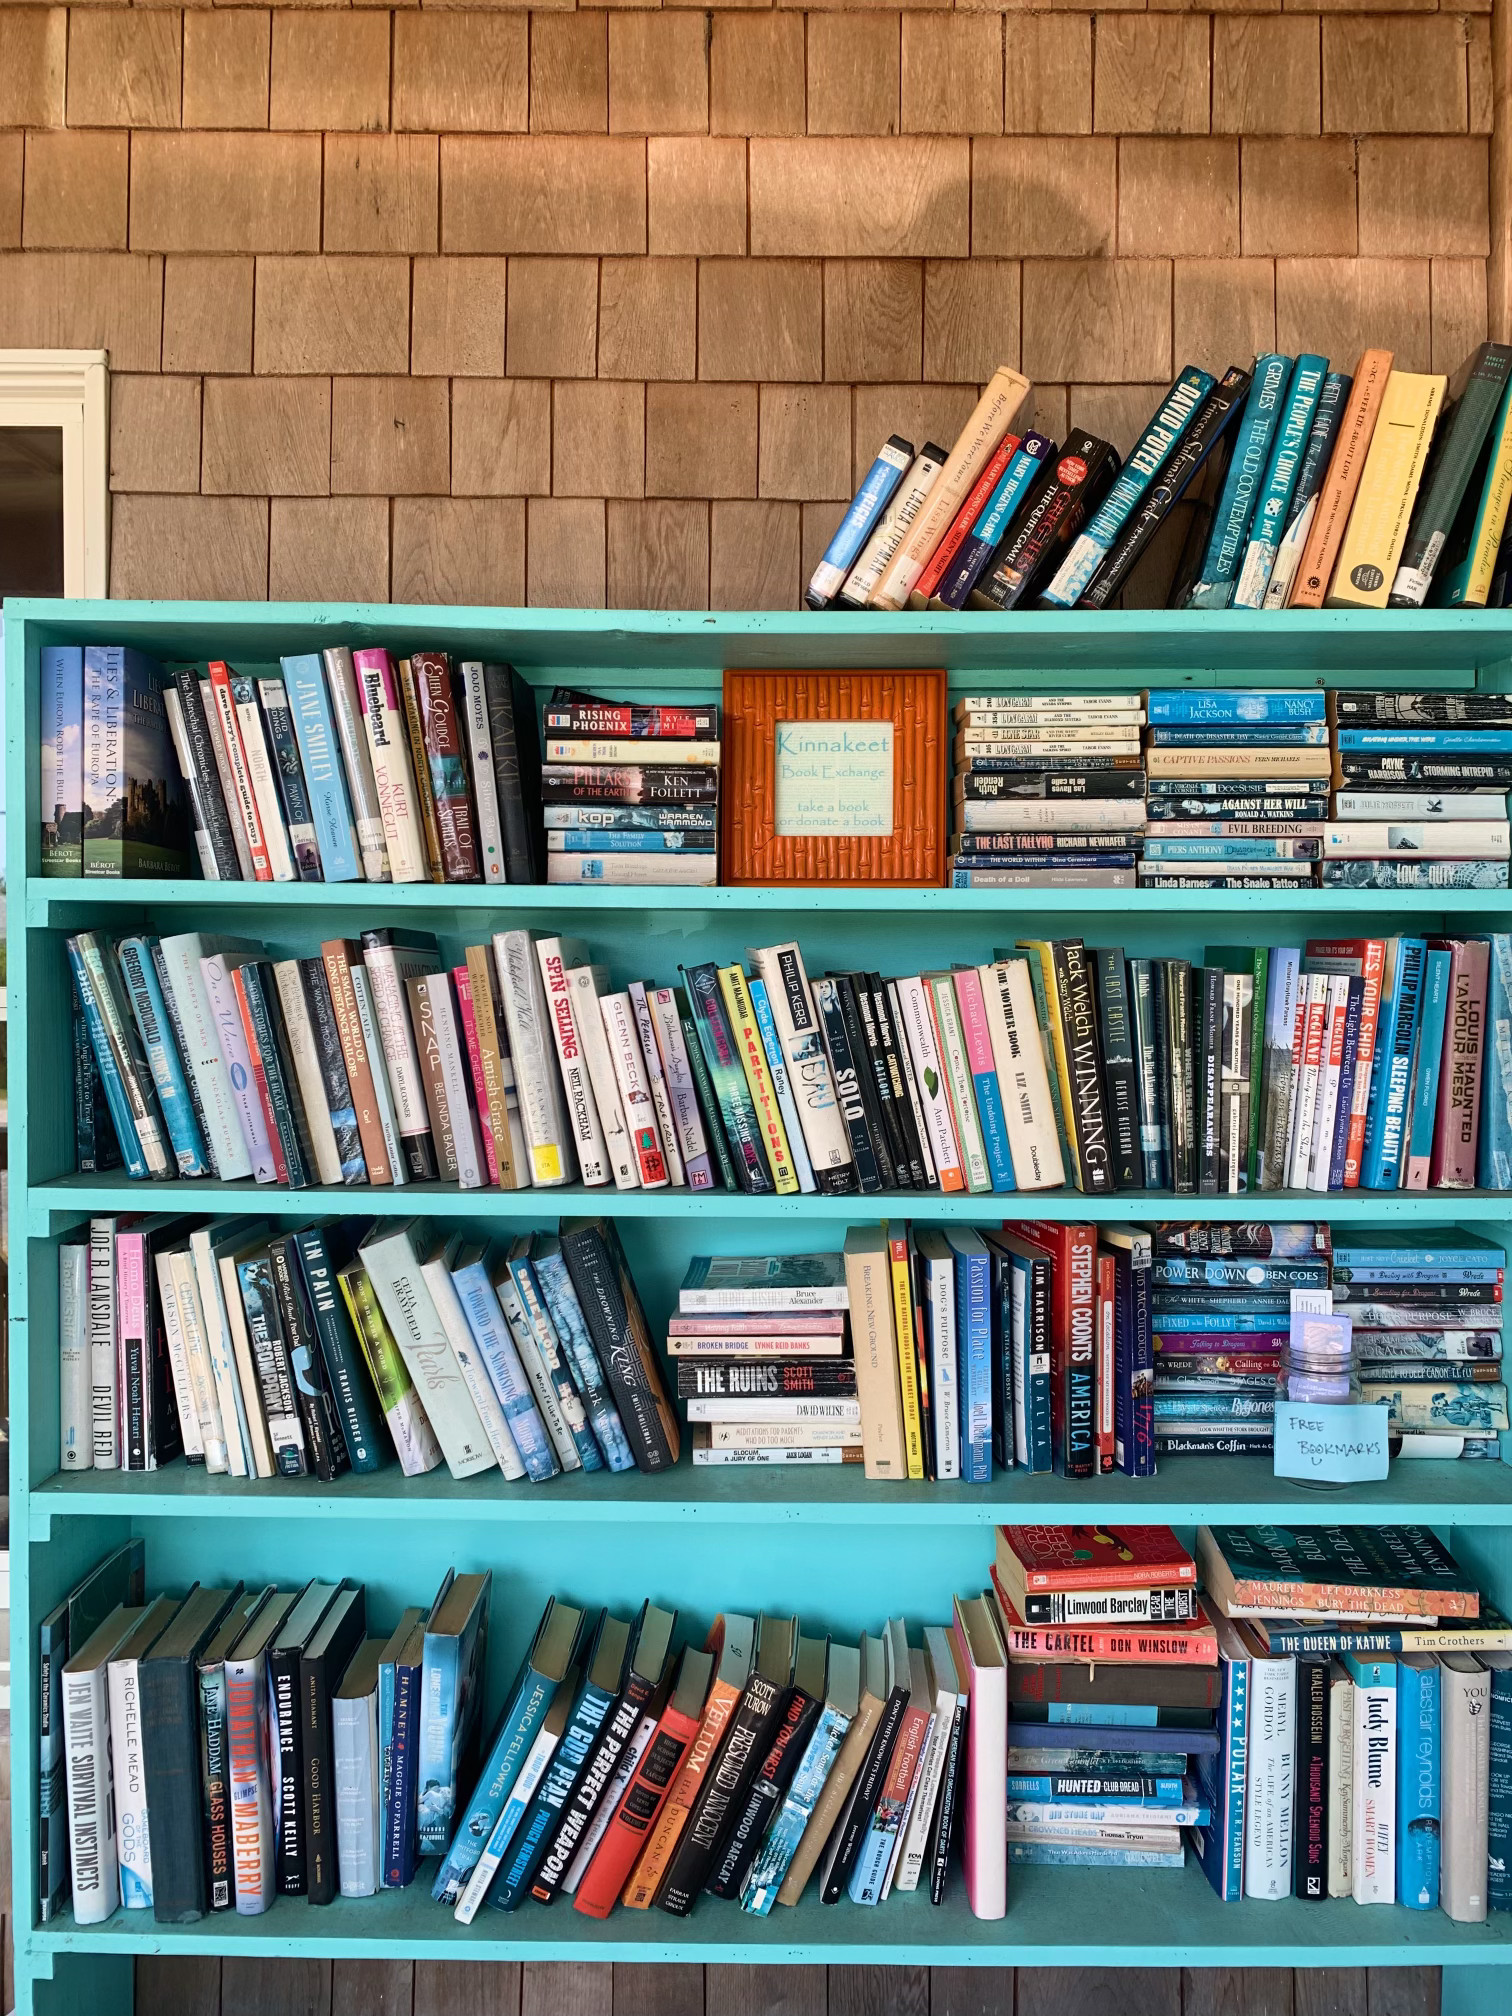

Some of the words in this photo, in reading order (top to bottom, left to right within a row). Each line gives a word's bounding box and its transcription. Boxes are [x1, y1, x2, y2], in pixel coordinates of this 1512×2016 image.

[1258, 361, 1283, 411] GRIMES
[1159, 382, 1201, 435] DAVID
[1131, 424, 1175, 476] POYER
[1250, 419, 1269, 445] THE
[1243, 446, 1262, 474] OLD
[1090, 476, 1142, 542] TOMAHAWK
[1217, 474, 1253, 575] CONTEMPTIBLES
[295, 680, 321, 718] JANE
[363, 672, 390, 748] Bluebeard
[579, 711, 621, 720] RISING
[1190, 707, 1232, 719] JACKSON
[1198, 701, 1217, 709] LISA
[1284, 701, 1315, 709] NANCY
[1288, 708, 1312, 716] BUSH
[573, 721, 627, 731] PHOENIX
[776, 729, 889, 755] Kinnakeet
[304, 722, 333, 783] SMILEY
[1163, 755, 1205, 764] CAPTIVE
[1207, 755, 1251, 764] PASSIONS
[1382, 758, 1404, 770] PAYNE
[574, 767, 631, 786] PILLARS
[664, 776, 689, 786] KEN
[782, 764, 818, 779] Book
[822, 764, 885, 780] Exchange
[1368, 770, 1407, 780] HARRISON
[1423, 766, 1461, 777] STORMING
[1462, 766, 1494, 777] INTREPID
[376, 766, 399, 840] VONNEGUT
[391, 783, 409, 819] KURT
[573, 788, 585, 796] OF
[587, 788, 602, 796] THE
[604, 787, 631, 796] EARTH
[651, 787, 702, 798] FOLLETT
[798, 800, 823, 812] take
[827, 804, 835, 812] a
[838, 800, 870, 812] book
[1222, 799, 1266, 810] AGAINST
[1267, 799, 1283, 810] HER
[1285, 799, 1308, 809] WILL
[578, 809, 615, 827] kop
[796, 814, 839, 826] donate
[842, 818, 850, 826] a
[854, 814, 885, 826] book
[1228, 824, 1250, 834] EVIL
[1252, 823, 1303, 834] BREEDING
[1235, 810, 1259, 818] RONALD
[1267, 810, 1294, 818] WATKINS
[975, 836, 992, 849] THE
[993, 836, 1015, 849] LAST
[1017, 836, 1054, 849] TALLYHO
[1057, 837, 1087, 847] RICHARD
[1089, 837, 1126, 847] NEWHAFER
[1155, 878, 1178, 888] Linda
[1179, 878, 1209, 888] Barnes
[1226, 878, 1242, 888] The
[1244, 878, 1270, 888] Snake
[1271, 878, 1298, 888] Tattoo
[546, 956, 565, 993] SPIN
[1063, 945, 1083, 980] Jack
[1365, 942, 1383, 972] IT'S
[1405, 946, 1423, 992] PHILLIP
[1073, 983, 1094, 1038] Welch
[1361, 974, 1379, 1017] YOUR
[554, 998, 579, 1060] SELLING
[910, 988, 930, 1058] Commonwealth
[964, 980, 982, 1032] Michael
[973, 1033, 986, 1067] Lewis
[1357, 1020, 1373, 1058] SHIP
[1397, 995, 1415, 1055] MARGOLIN
[482, 1048, 500, 1095] Amish
[1387, 1056, 1409, 1119] SLEEPING
[743, 1027, 784, 1163] PARTITIONS
[835, 1067, 864, 1121] SOLO
[1072, 1039, 1107, 1165] WINNING
[1205, 1054, 1215, 1157] DISAPPEARANCES
[490, 1099, 504, 1142] Grace
[934, 1108, 944, 1127] Ann
[938, 1128, 951, 1164] Patchett
[1381, 1119, 1400, 1164] BEAUTY
[1030, 1145, 1042, 1182] Doubleday
[91, 1227, 110, 1253] JOE
[304, 1239, 323, 1261] IN
[310, 1267, 337, 1312] PAIN
[1072, 1244, 1092, 1304] STEPHEN
[1156, 1266, 1199, 1278] POWER
[1205, 1268, 1247, 1280] DOWN
[1266, 1271, 1288, 1280] BEN
[1289, 1271, 1319, 1280] COES
[91, 1280, 111, 1347] LANSDALE
[1072, 1308, 1092, 1362] COONTS
[695, 1368, 726, 1392] THE
[730, 1366, 778, 1392] RUINS
[784, 1367, 813, 1377] SCOTT
[784, 1380, 814, 1390] SMITH
[1071, 1372, 1090, 1452] AMERICA
[1289, 1417, 1324, 1431] FREE
[1167, 1440, 1214, 1450] Blackman's
[1217, 1440, 1246, 1451] Coffin
[1297, 1441, 1380, 1455] BOOKMARKS
[1067, 1597, 1108, 1615] Linwood
[1110, 1595, 1148, 1615] Barclay
[1251, 1582, 1304, 1593] MAUREEN
[1252, 1595, 1304, 1607] JENNINGS
[1014, 1632, 1037, 1650] THE
[1045, 1633, 1095, 1653] CARTEL
[1110, 1639, 1132, 1652] DON
[1138, 1640, 1188, 1654] WINSLOW
[1280, 1637, 1300, 1650] THE
[1303, 1637, 1337, 1650] QUEEN
[1340, 1636, 1353, 1649] OF
[1356, 1636, 1391, 1649] KATWE
[1415, 1636, 1429, 1646] Tim
[1432, 1634, 1485, 1646] Crothers
[69, 1682, 92, 1703] JEN
[1463, 1688, 1488, 1698] YOU
[69, 1706, 94, 1749] WAITE
[228, 1680, 257, 1783] JONATHAN
[277, 1675, 293, 1753] ENDURANCE
[610, 1701, 639, 1738] THE
[1363, 1697, 1389, 1732] Judy
[686, 1698, 733, 1773] VELLUM
[577, 1735, 621, 1810] PERFECT
[1368, 1737, 1389, 1788] Blume
[72, 1755, 95, 1818] SURVIVAL
[283, 1777, 295, 1816] SCOTT
[235, 1803, 262, 1896] MABERRY
[283, 1819, 297, 1857] KELLY
[540, 1809, 588, 1885] WEAPON
[74, 1821, 99, 1892] INSTINCTS
